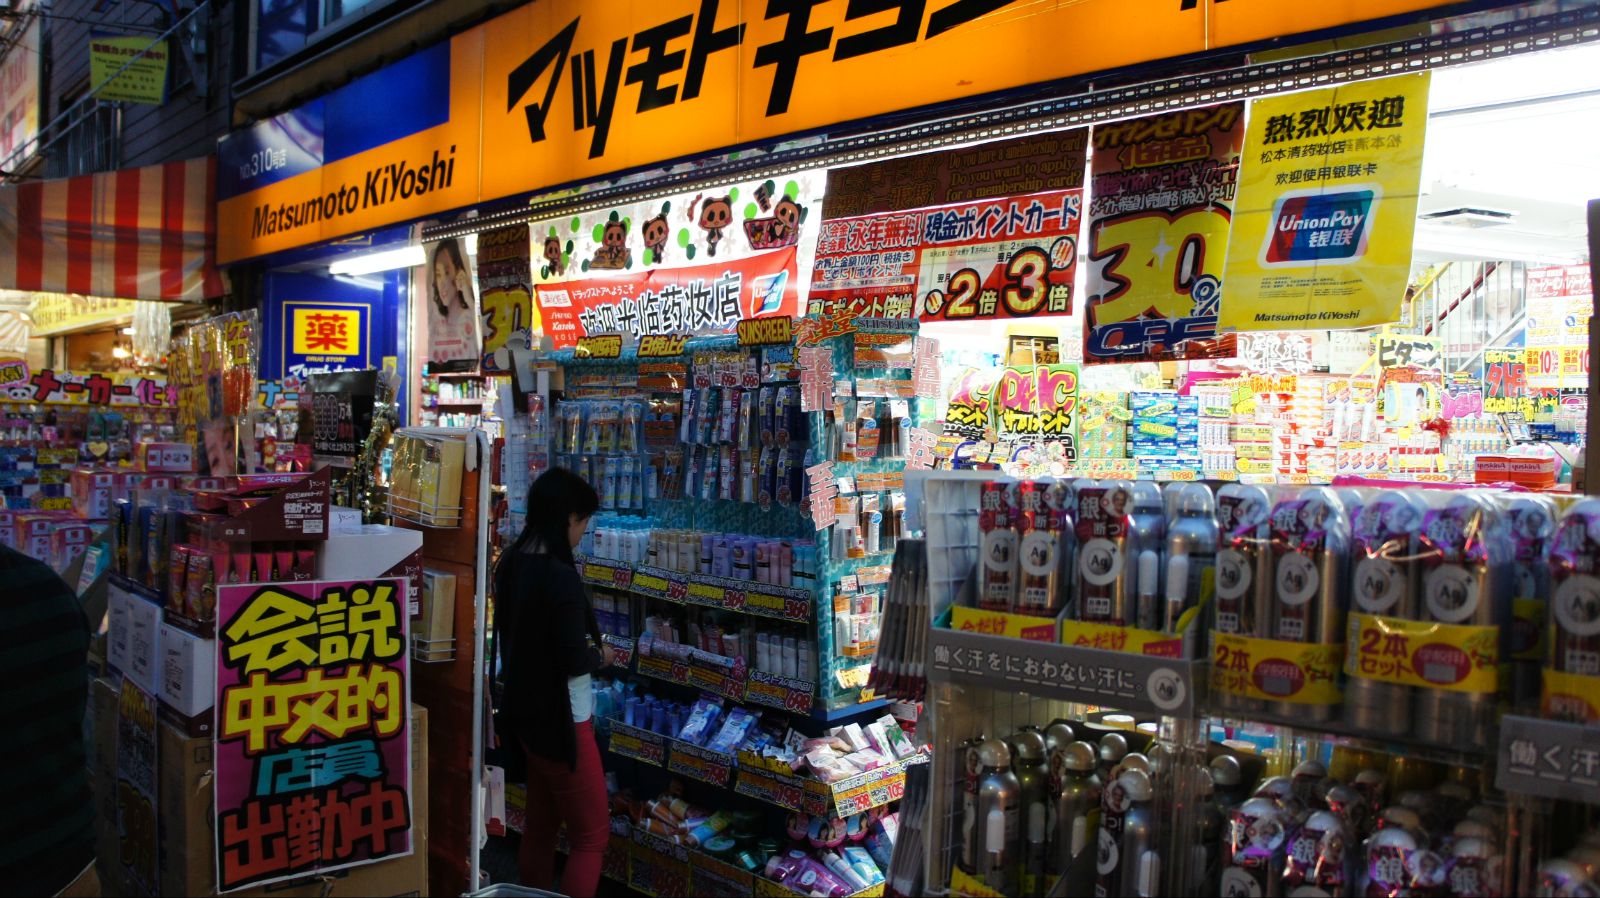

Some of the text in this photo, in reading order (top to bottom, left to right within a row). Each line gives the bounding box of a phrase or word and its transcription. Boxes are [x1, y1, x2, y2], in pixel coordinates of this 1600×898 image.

[1262, 96, 1405, 145] 热烈欢迎
[1260, 140, 1347, 164] 松本清药妆店
[969, 170, 991, 185] you
[1041, 158, 1074, 175] apply
[1274, 163, 1378, 185] 欢迎使用银联卡
[251, 144, 456, 240] Matsumoto KiYoshi
[976, 176, 1044, 198] membership
[821, 223, 849, 239] 入会金
[850, 215, 921, 250] 永年無料
[925, 195, 1081, 242] 現金ポイントカード
[1279, 210, 1364, 233] UnionPay
[817, 239, 847, 252] 年会費
[1309, 229, 1353, 248] 银联
[947, 271, 979, 317] 2
[1006, 250, 1048, 313] 3
[979, 288, 999, 316] 倍
[1048, 285, 1068, 312] 倍
[1254, 310, 1360, 322] Matsumoto KiYoshi
[306, 314, 348, 351] 薬
[737, 317, 791, 346] SUNSCREEN
[999, 366, 1078, 413] DHC
[982, 490, 1001, 512] 銀
[1022, 490, 1042, 513] 銀
[1080, 496, 1100, 519] 銀
[1360, 628, 1410, 658] 2本
[934, 645, 1144, 691] 働く汗をにおわない汗に。
[1215, 644, 1251, 673] 2本
[1360, 656, 1414, 678] セット
[224, 664, 402, 751] 中文的
[256, 739, 383, 796] 店員
[223, 781, 407, 886] 出勤中
